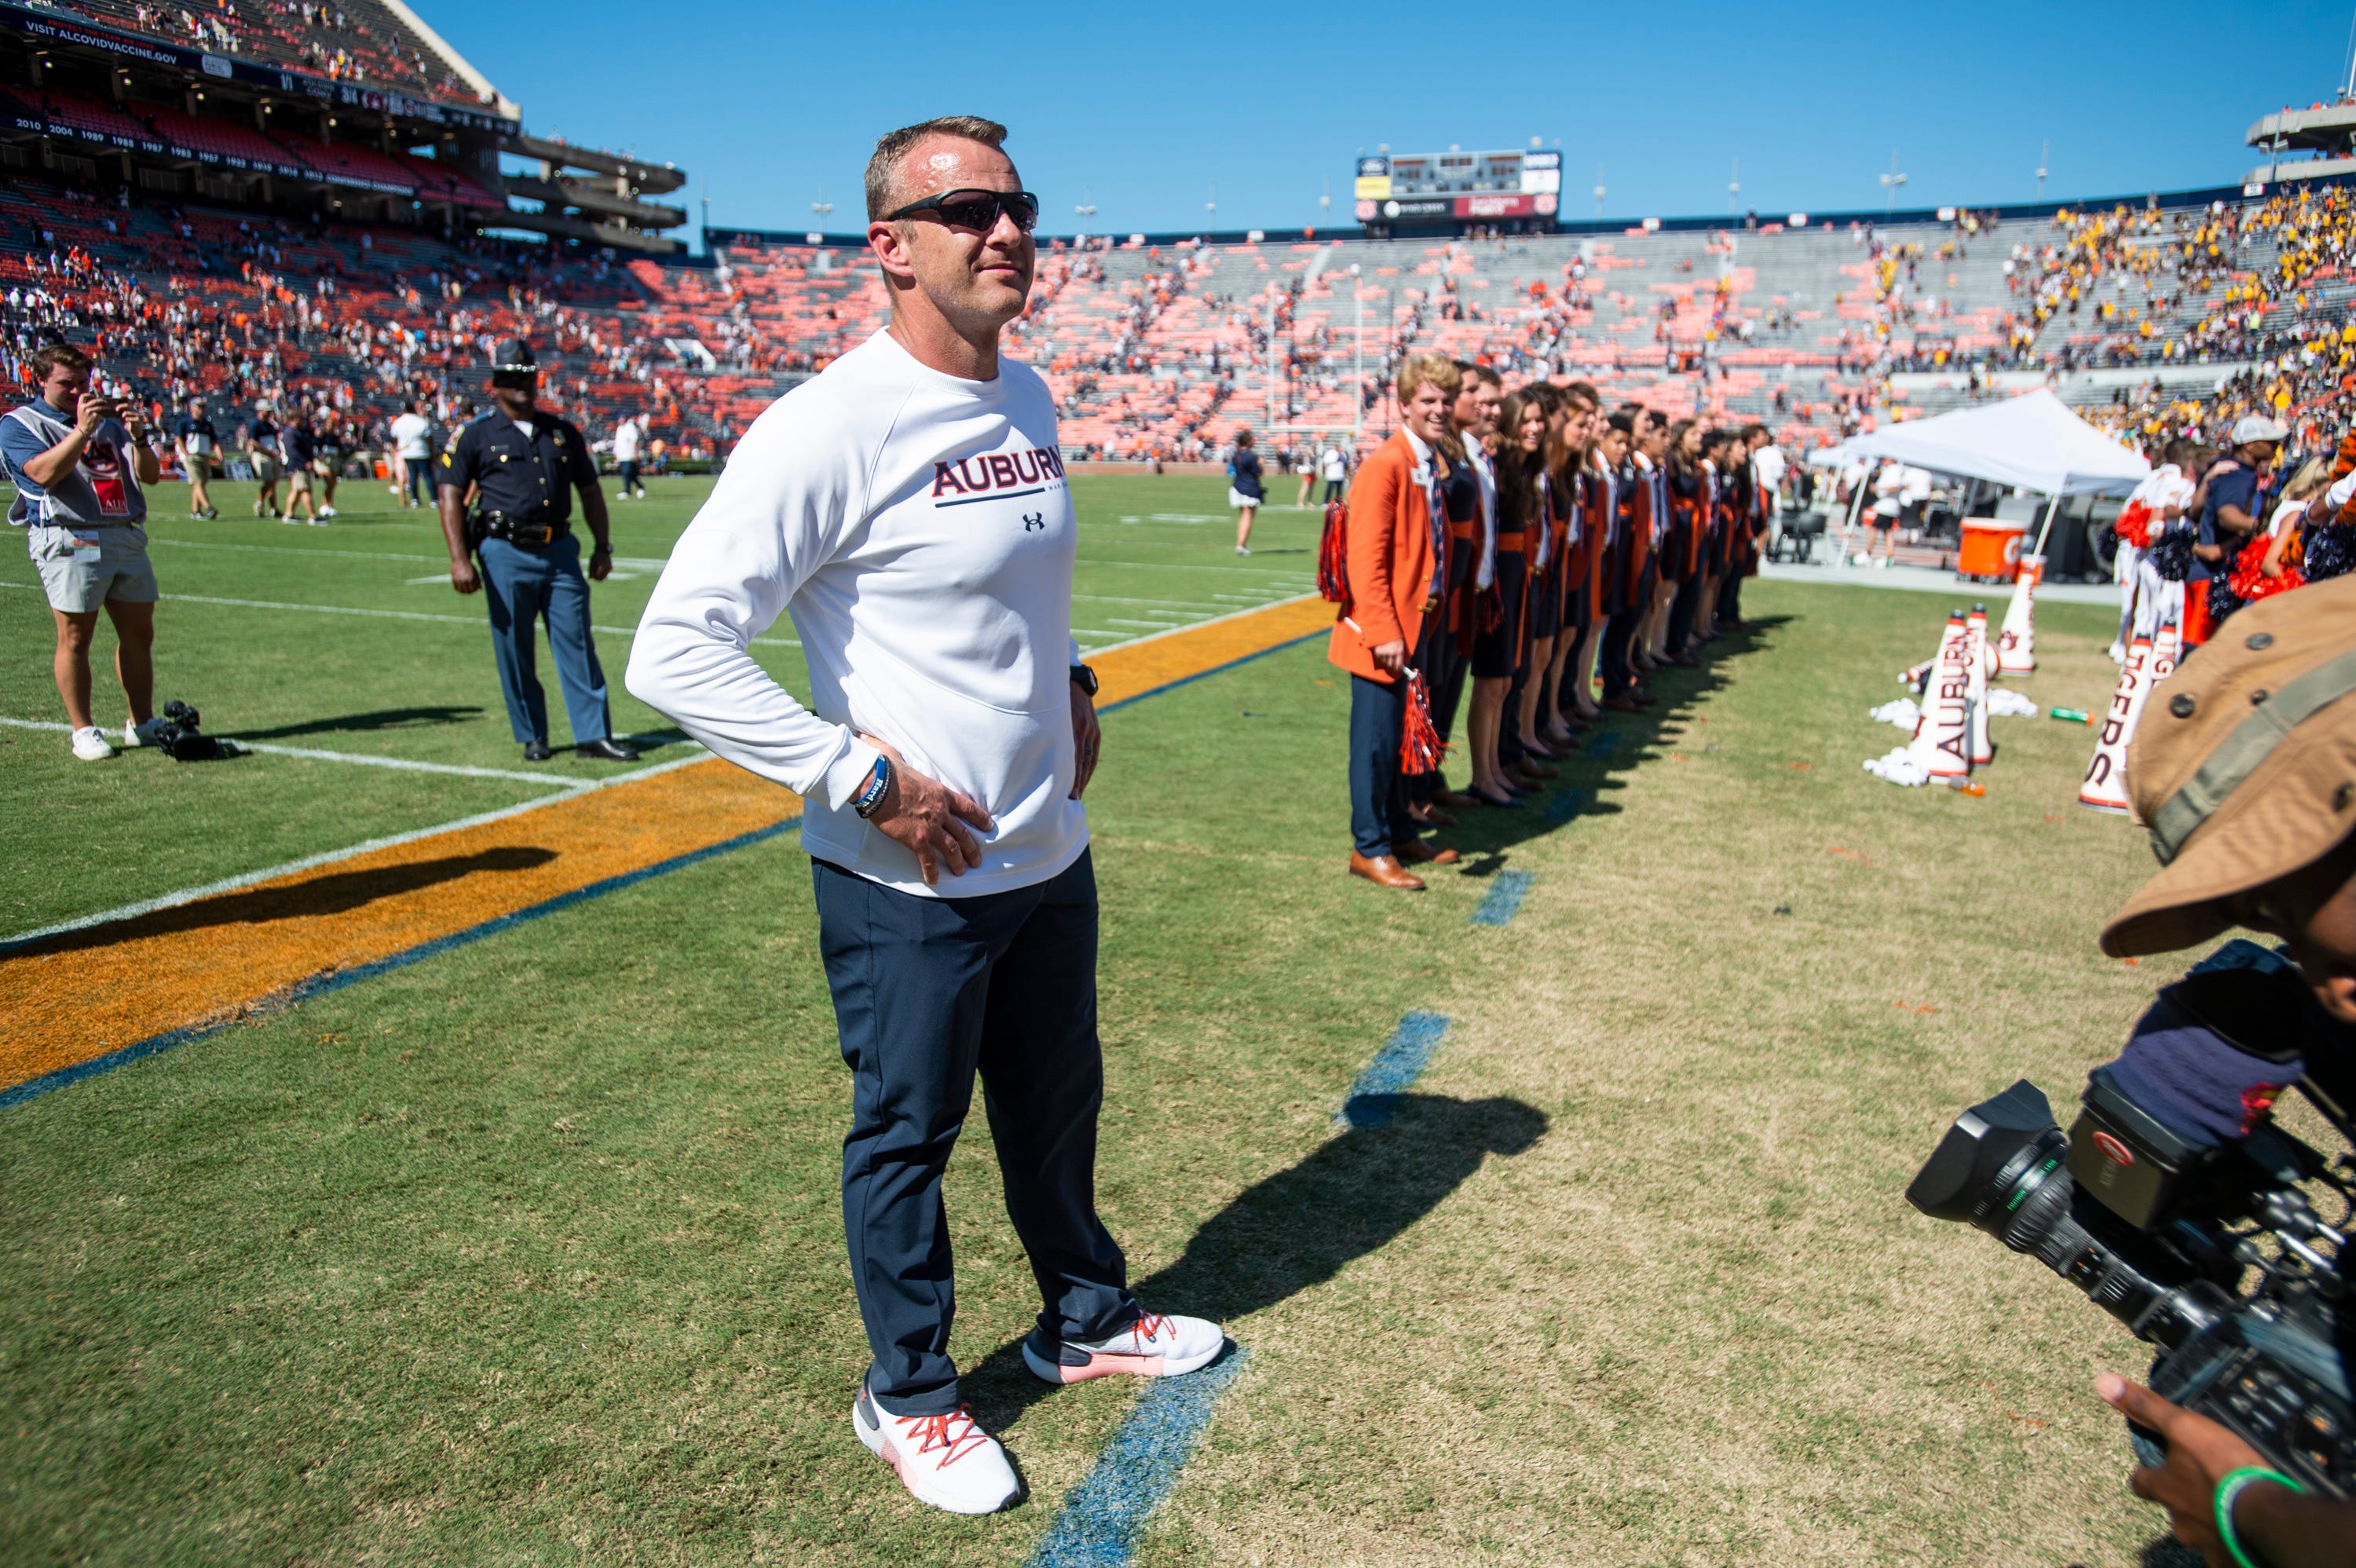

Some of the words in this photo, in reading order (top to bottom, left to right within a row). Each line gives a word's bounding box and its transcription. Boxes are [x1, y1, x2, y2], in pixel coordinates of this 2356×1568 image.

[26, 20, 56, 37] VISIT
[59, 29, 177, 65] ALCOVIDVACCINE.GOV
[16, 118, 41, 131] 2010
[49, 124, 73, 137] 2004
[82, 130, 104, 143] 1989
[112, 135, 134, 148] 1988
[142, 141, 163, 153] 1987
[932, 444, 1066, 498] AUBURN
